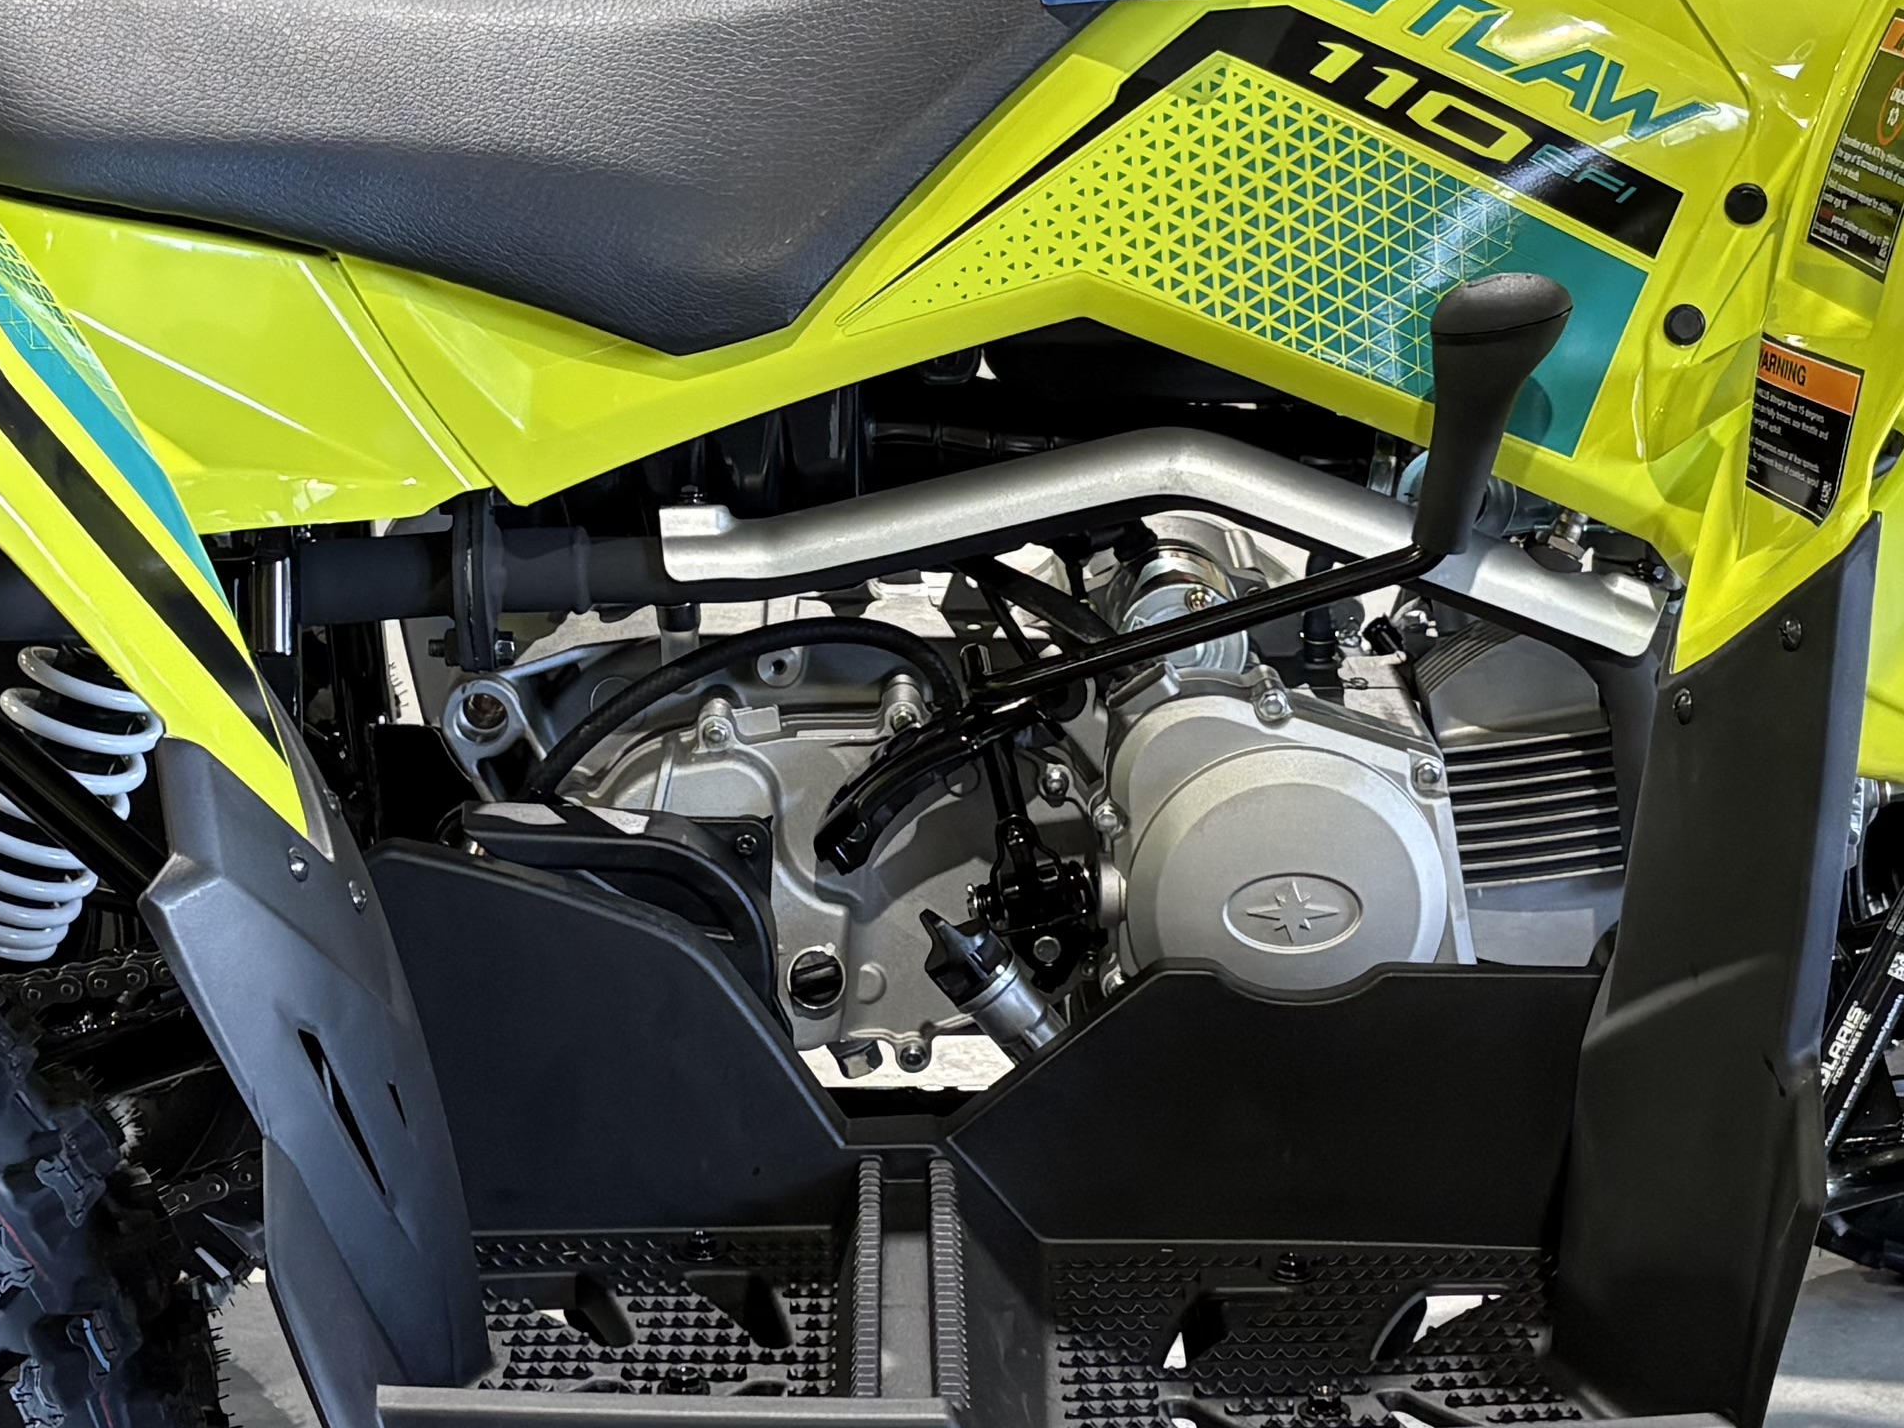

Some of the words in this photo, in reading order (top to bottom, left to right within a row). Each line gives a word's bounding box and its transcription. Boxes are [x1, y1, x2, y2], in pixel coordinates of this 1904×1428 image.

[1309, 40, 1533, 164] 110
[1529, 144, 1639, 204] EFI
[1828, 1030, 1865, 1086] INDUSTRIES
